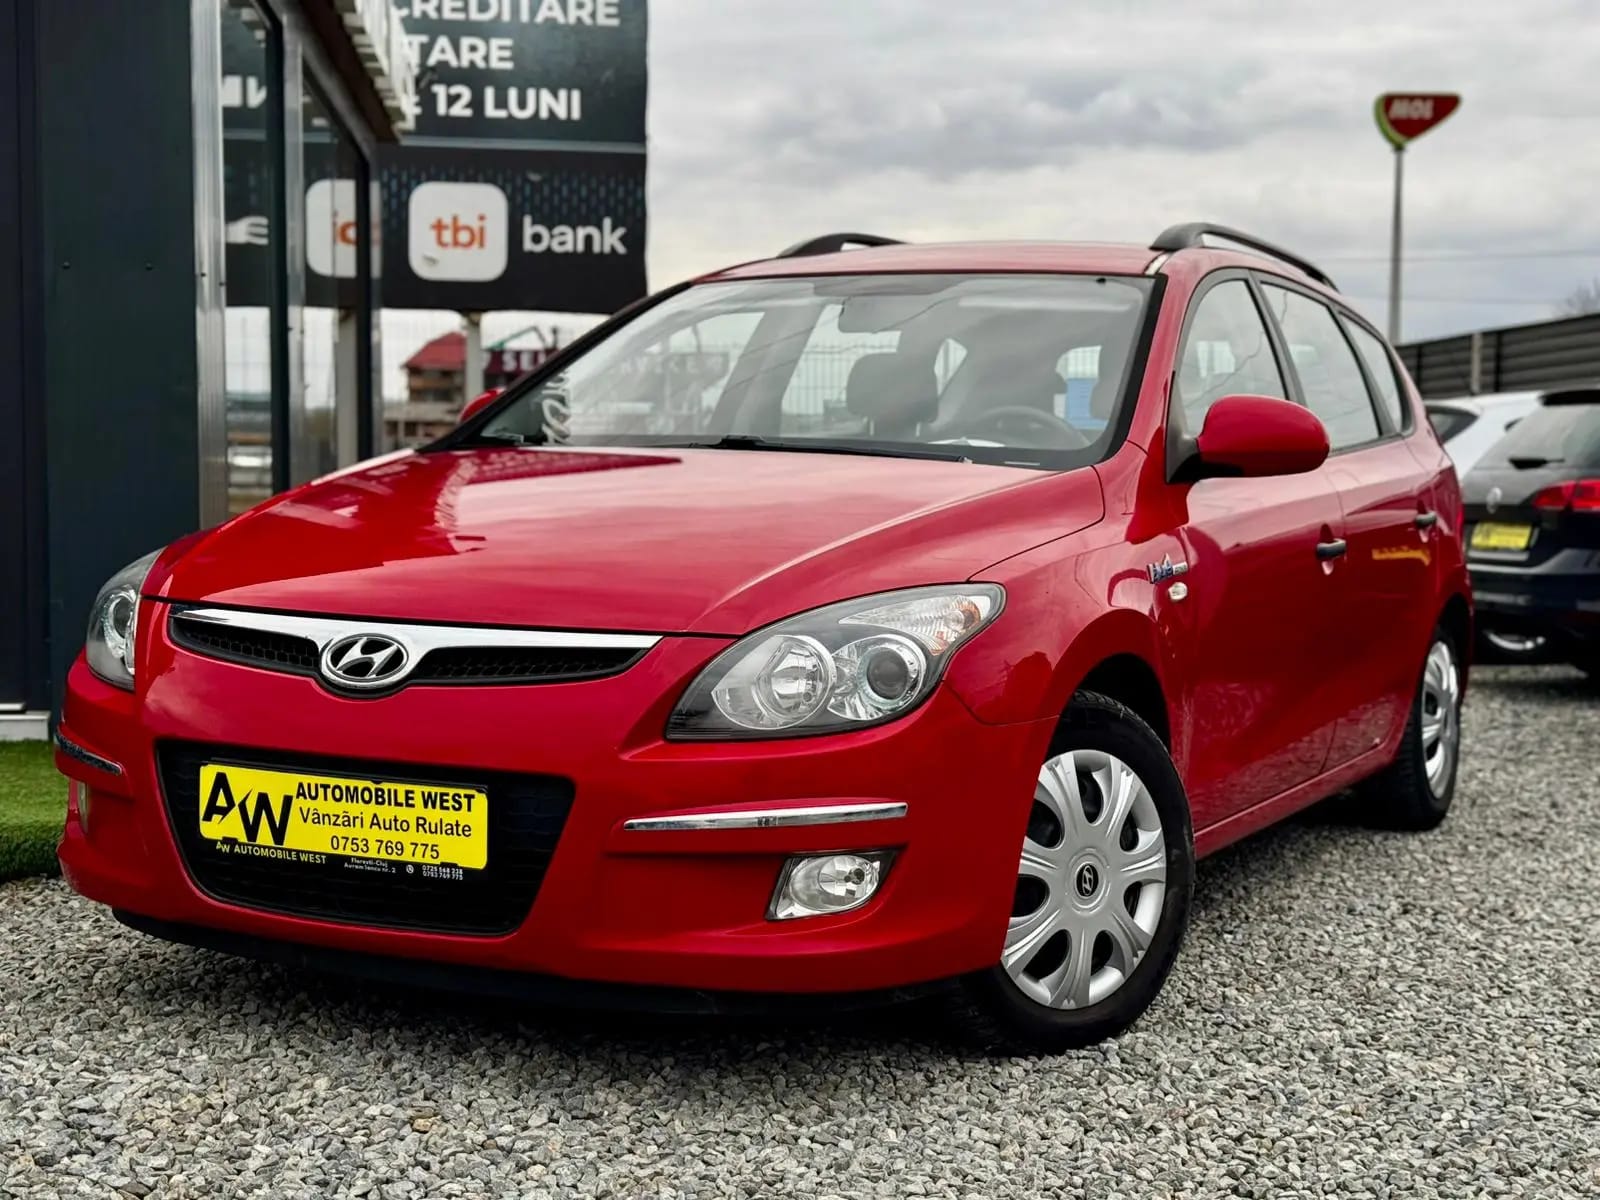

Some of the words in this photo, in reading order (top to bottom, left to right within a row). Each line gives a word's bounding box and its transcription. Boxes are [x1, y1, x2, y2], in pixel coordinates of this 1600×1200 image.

[430, 83, 473, 118] 12
[484, 85, 582, 121] LUNI
[430, 213, 487, 249] tbi
[522, 214, 628, 255] bank
[296, 781, 416, 809] AUTOMOBILE
[421, 790, 476, 813] WEST
[369, 812, 410, 833] Auto
[415, 816, 472, 838] Rulate
[233, 844, 298, 861] AUTOMOBILE
[299, 852, 327, 865] WEST
[330, 834, 370, 854] 0753
[375, 839, 405, 857] 769
[409, 842, 440, 860] 775
